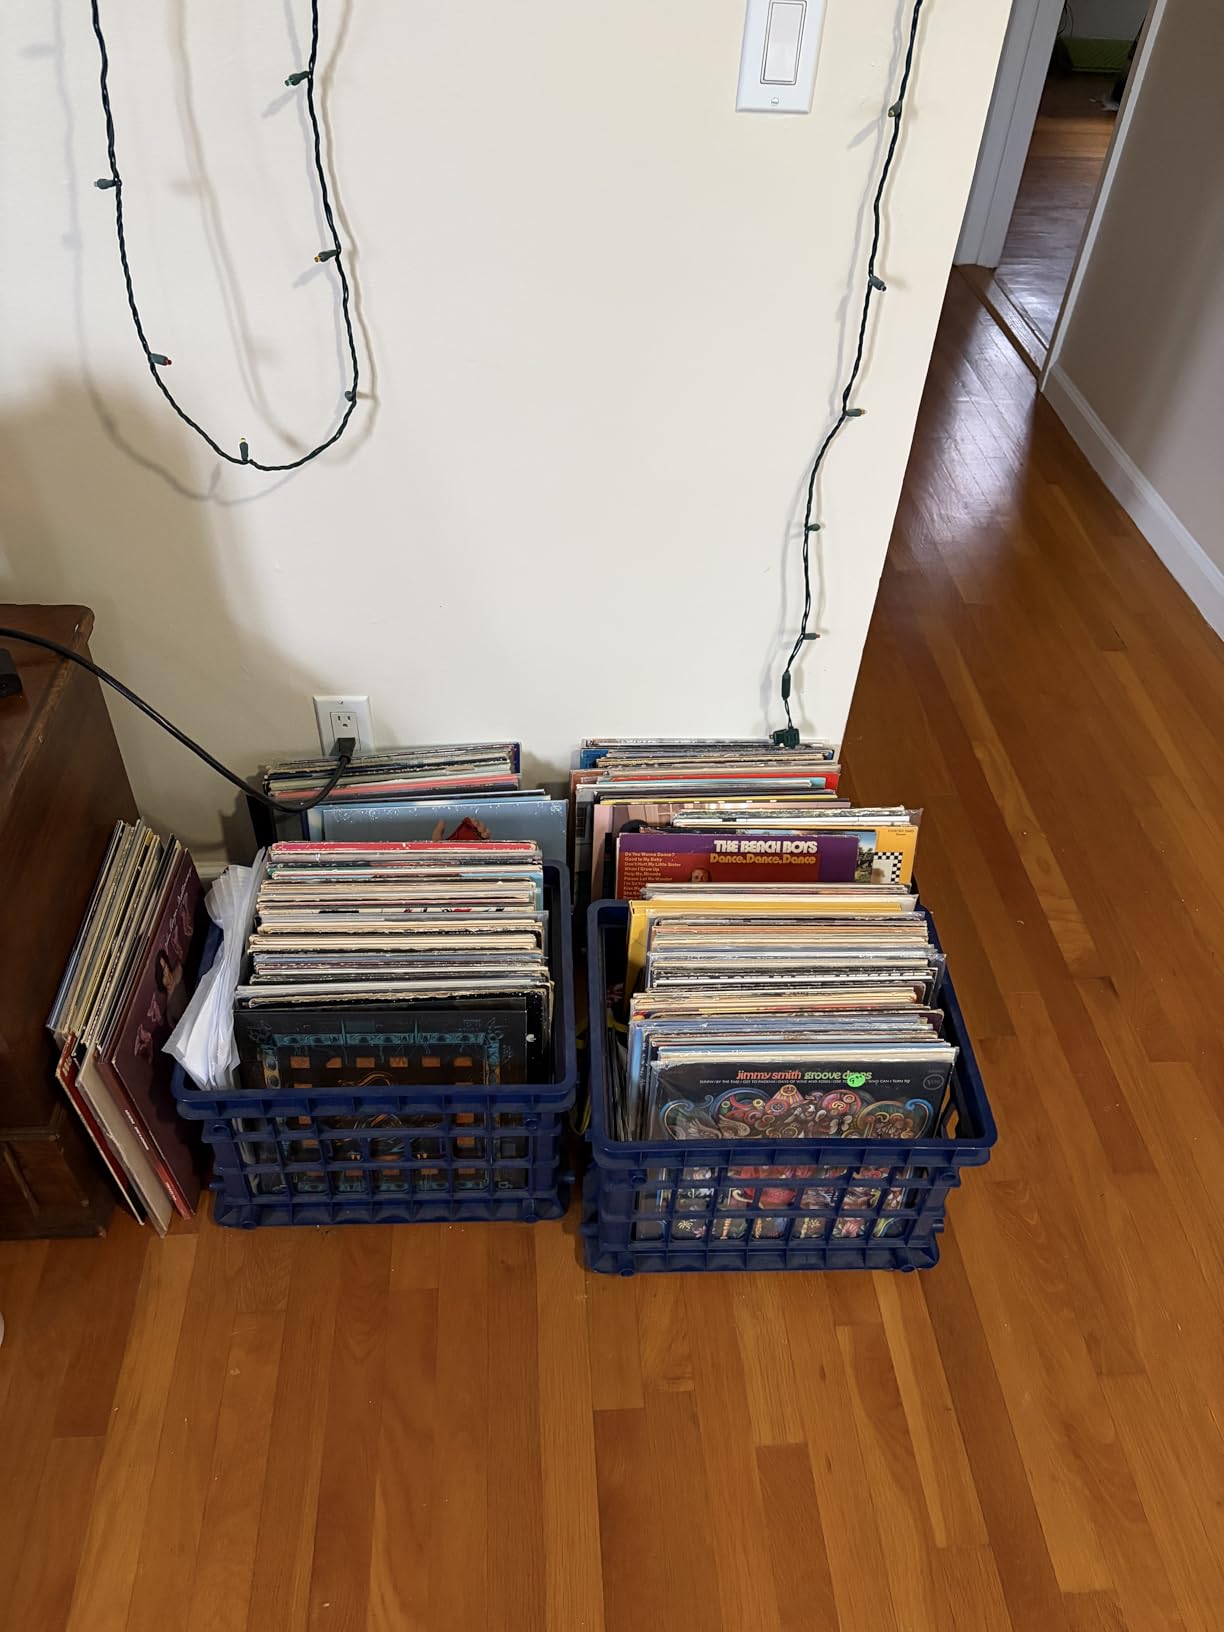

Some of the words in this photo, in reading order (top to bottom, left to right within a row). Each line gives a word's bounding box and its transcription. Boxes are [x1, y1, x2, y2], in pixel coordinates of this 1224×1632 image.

[714, 840, 738, 853] THE
[740, 840, 781, 853] BEACH
[782, 841, 818, 854] BOYS
[783, 854, 816, 865] Dance
[736, 1070, 771, 1080] jimmy
[771, 1070, 801, 1080] smith
[804, 1071, 842, 1080] groove
